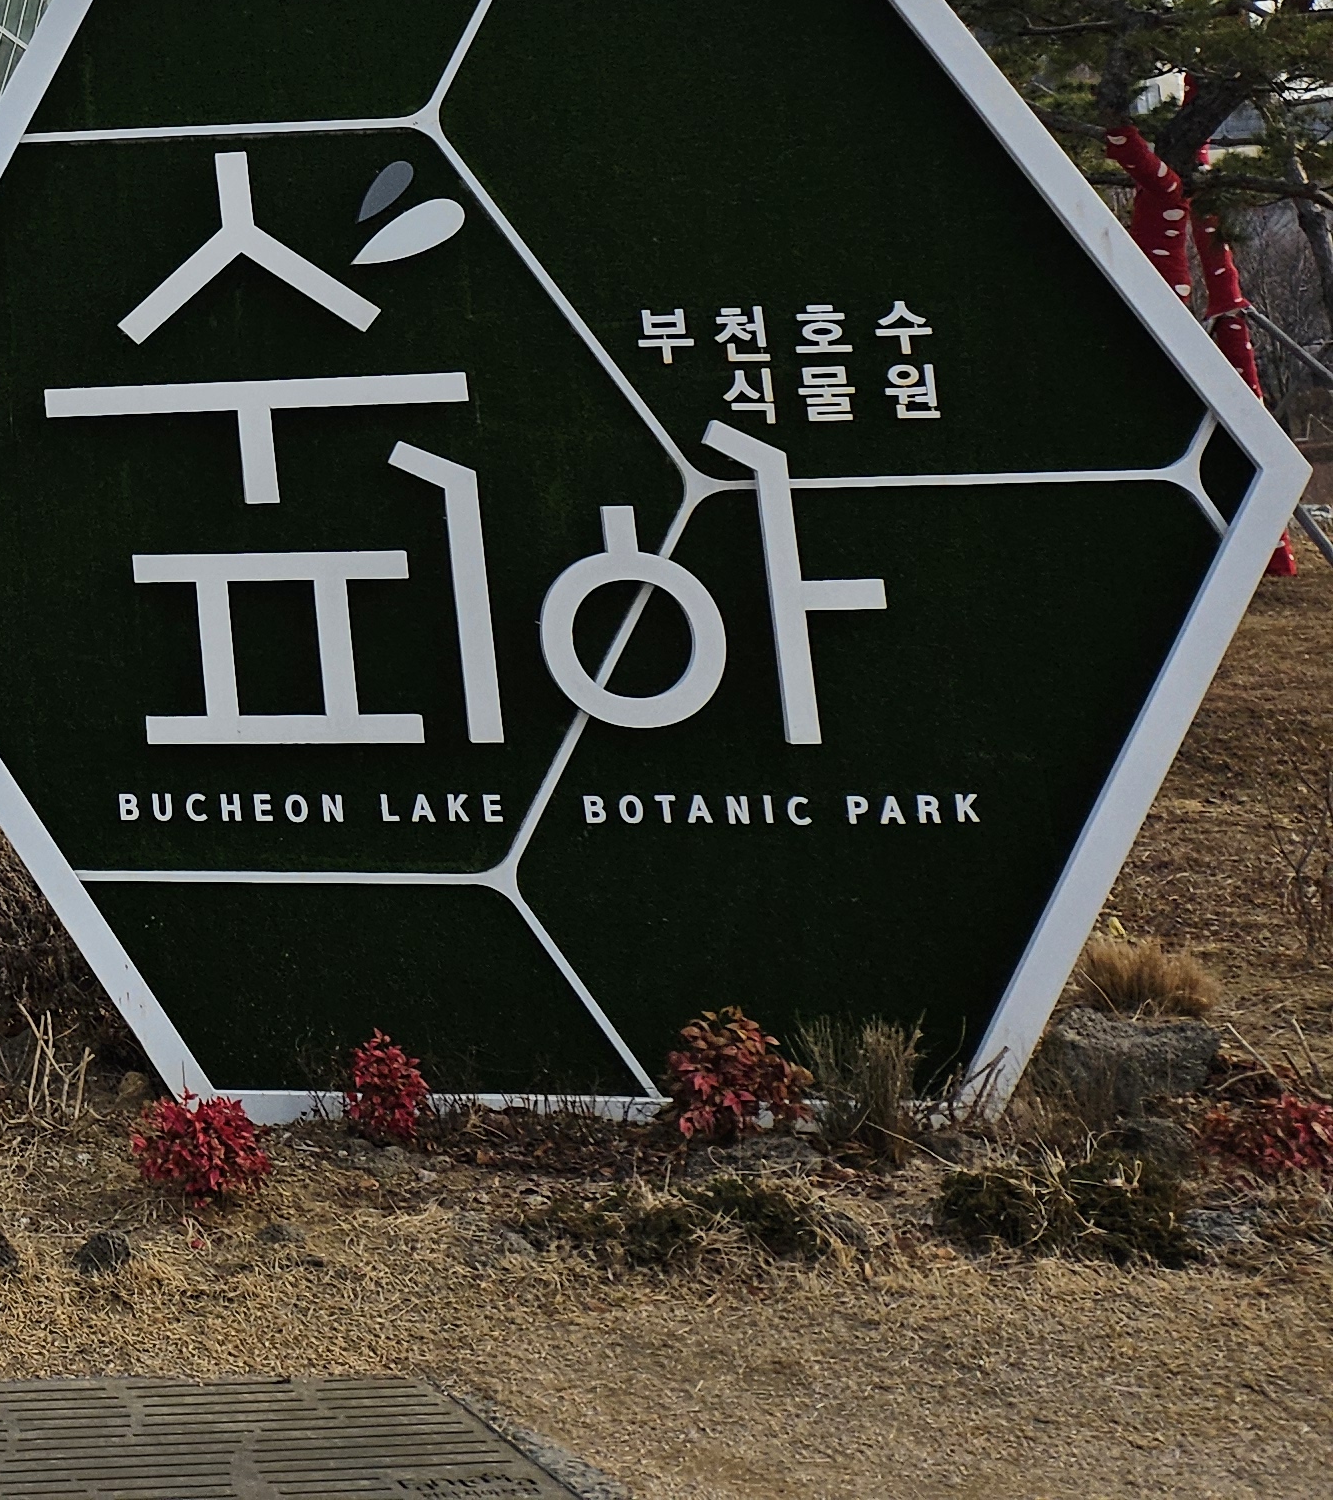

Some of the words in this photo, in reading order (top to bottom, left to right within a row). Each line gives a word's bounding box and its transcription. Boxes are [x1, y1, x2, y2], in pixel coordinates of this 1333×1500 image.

[722, 363, 942, 425] 식물원
[117, 792, 345, 824] BUCHEON
[379, 792, 505, 824] LAKE
[582, 792, 814, 826] BOTANIC
[846, 792, 981, 825] PARK
